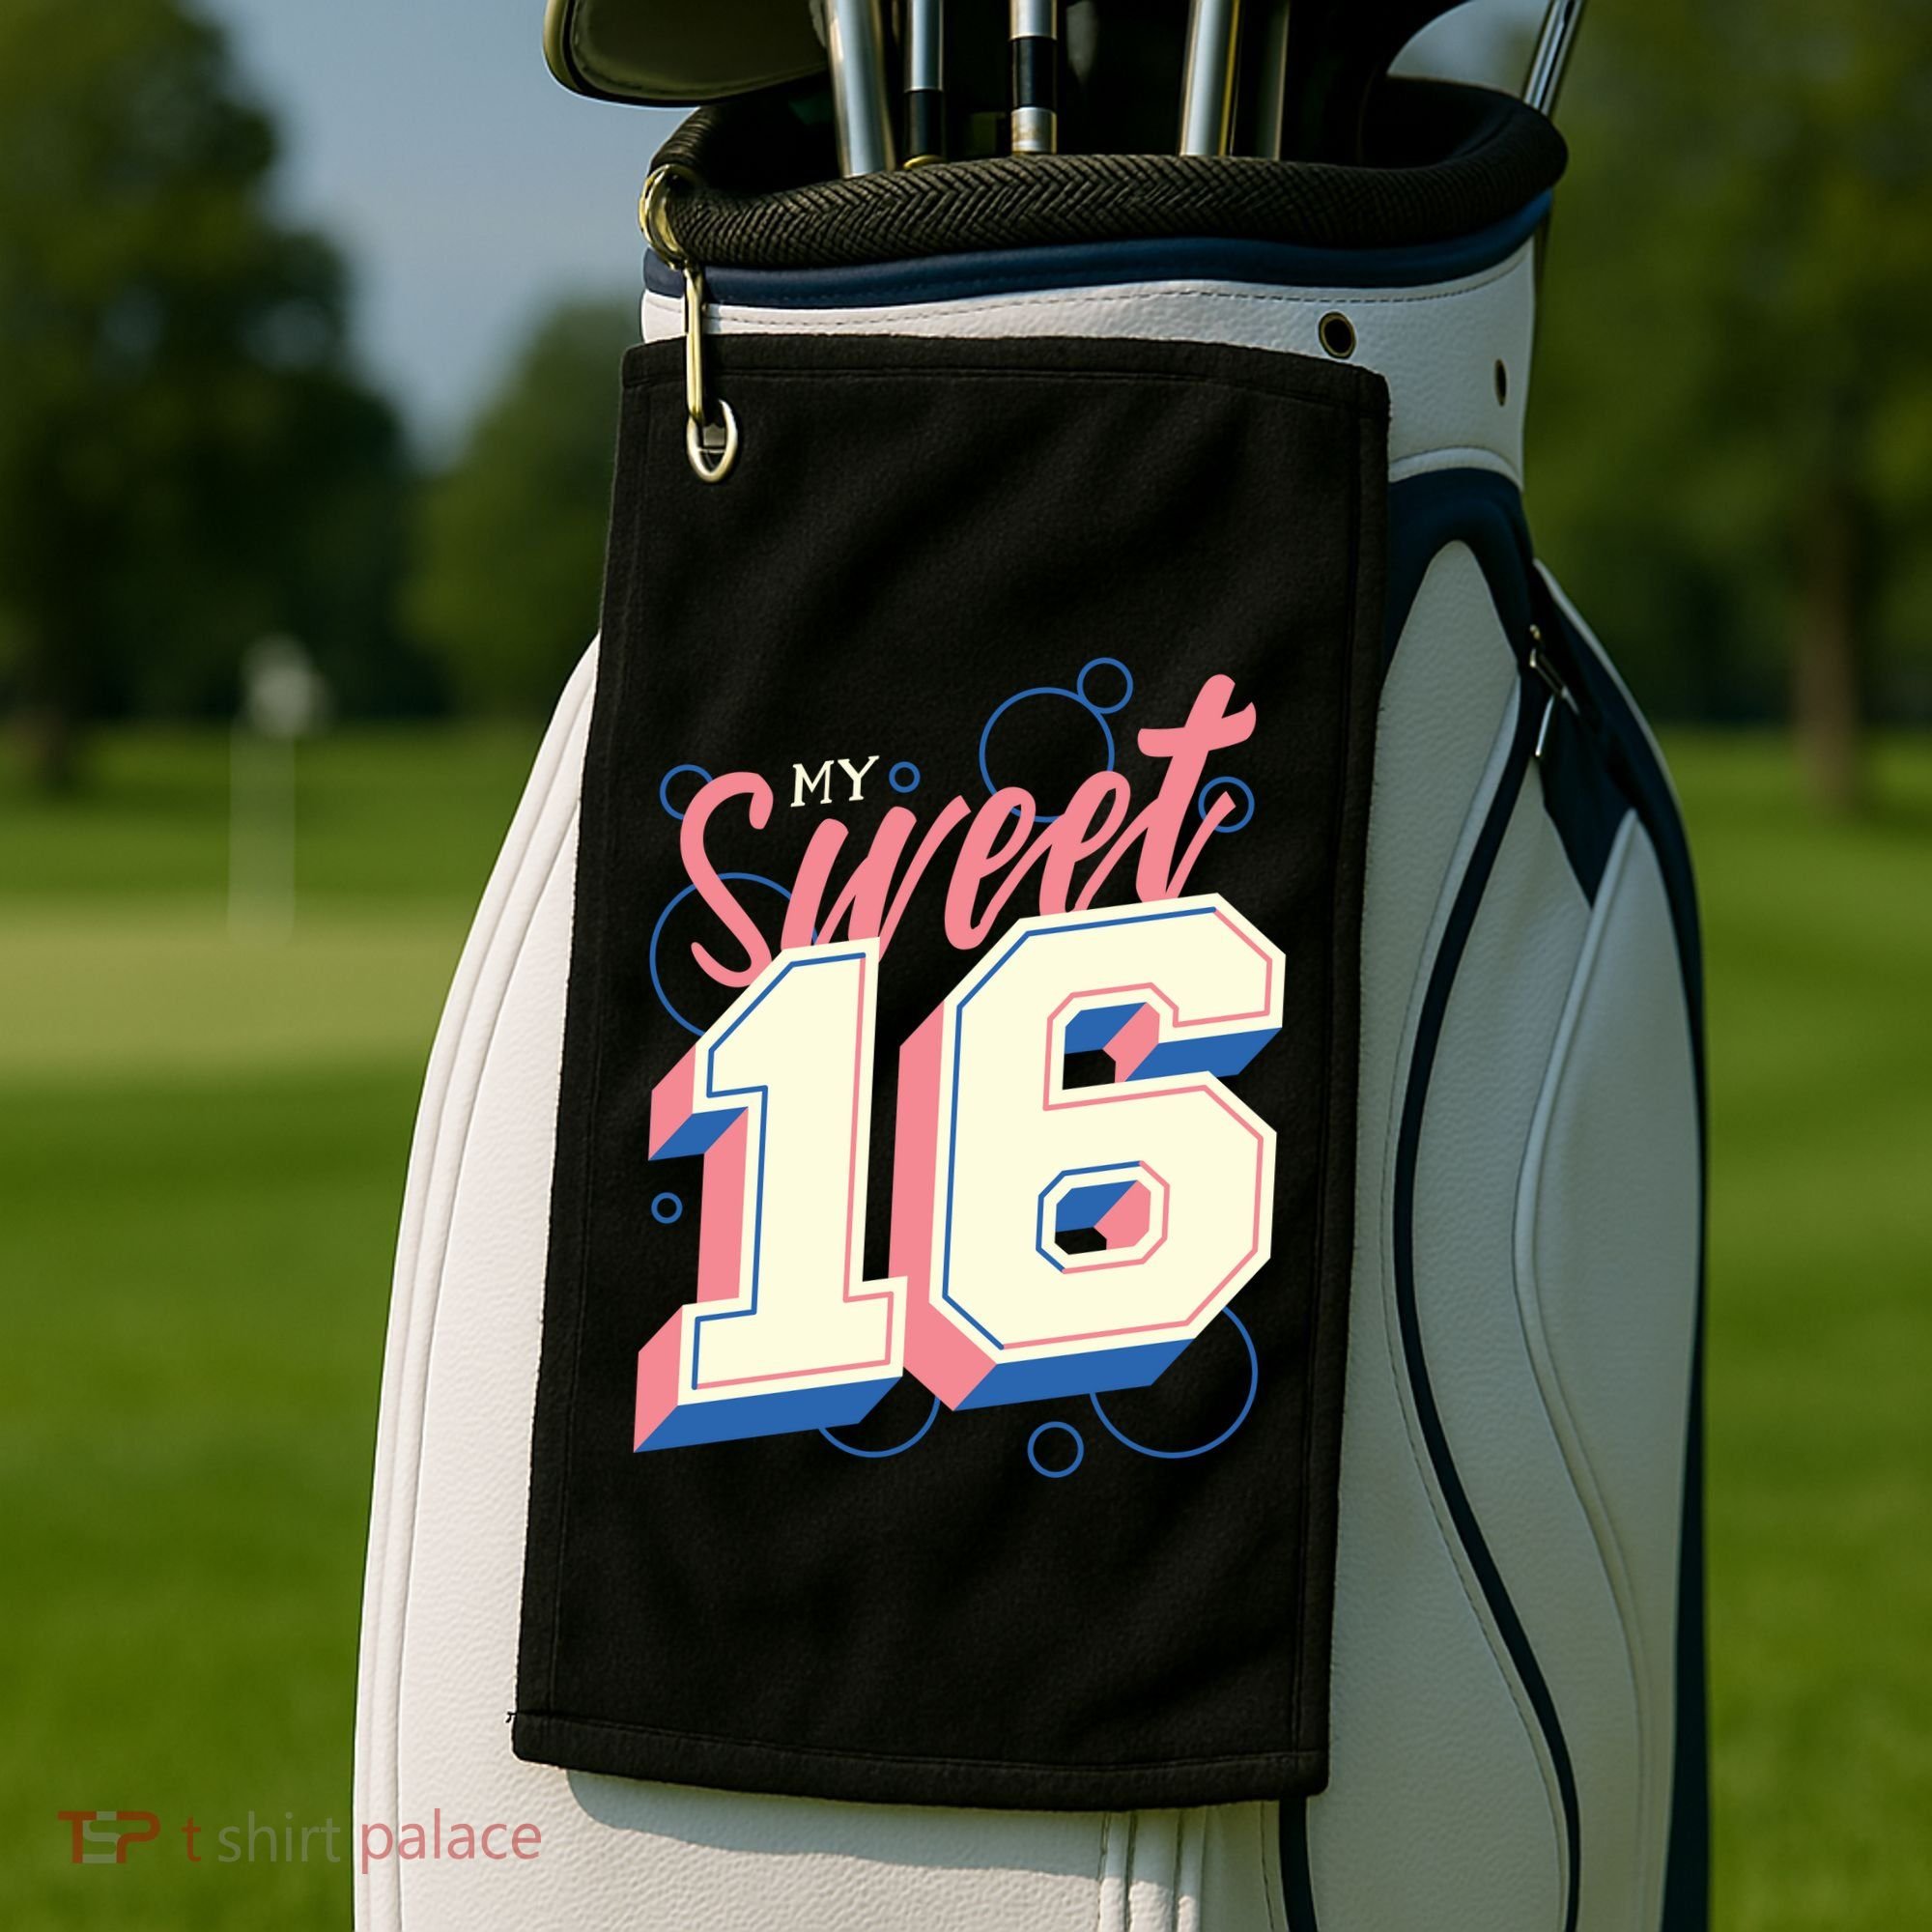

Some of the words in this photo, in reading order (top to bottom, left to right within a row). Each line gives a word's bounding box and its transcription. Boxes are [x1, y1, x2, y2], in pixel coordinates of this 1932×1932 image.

[679, 673, 1257, 987] Sweet
[790, 755, 879, 808] MY
[633, 893, 1286, 1453] 16
